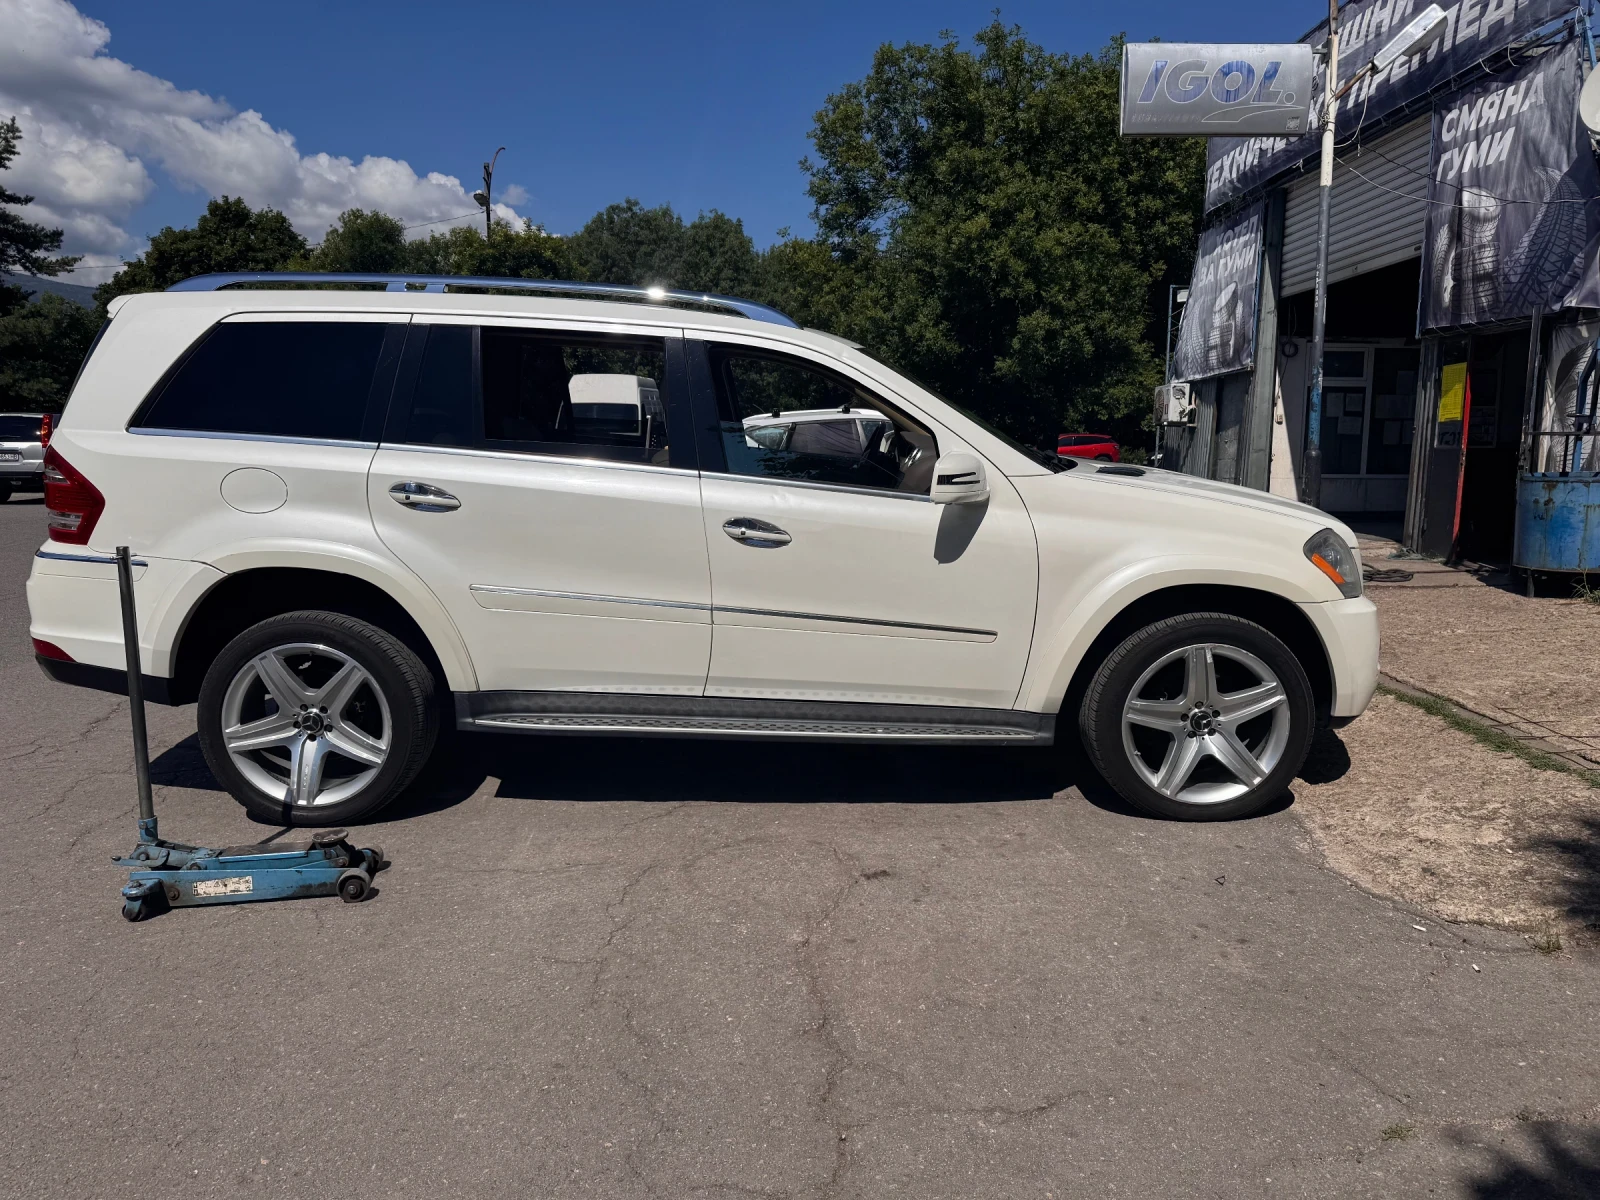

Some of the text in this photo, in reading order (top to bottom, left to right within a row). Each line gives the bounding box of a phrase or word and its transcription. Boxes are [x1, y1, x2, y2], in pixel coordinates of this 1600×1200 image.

[1347, 0, 1528, 110] ПРЕЛЕД
[1441, 71, 1545, 142] СМЯНА
[1435, 126, 1516, 184] ГУМИ
[1200, 243, 1256, 287] ЗА ГУМИ
